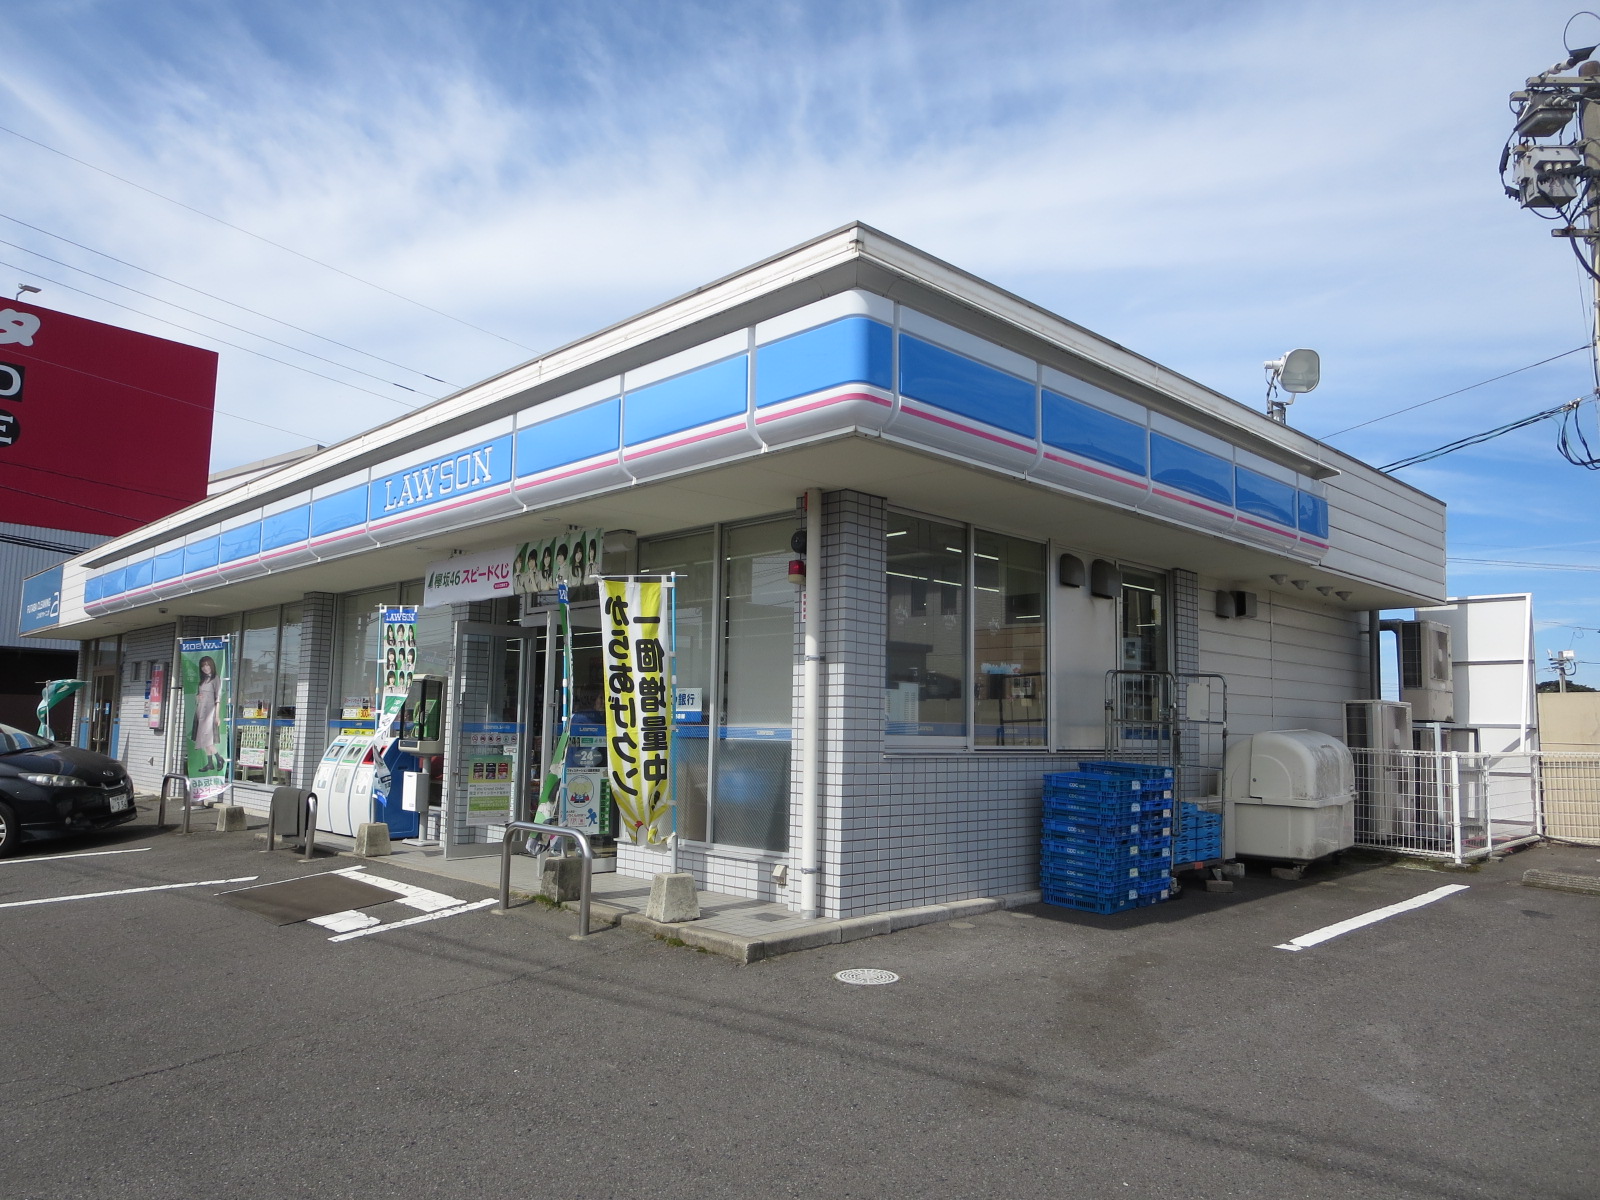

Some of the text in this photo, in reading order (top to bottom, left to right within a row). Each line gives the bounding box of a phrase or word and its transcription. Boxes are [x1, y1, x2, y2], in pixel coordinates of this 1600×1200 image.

[384, 446, 493, 512] LAWSON
[461, 563, 510, 585] スピードくじ
[580, 750, 594, 761] 24
